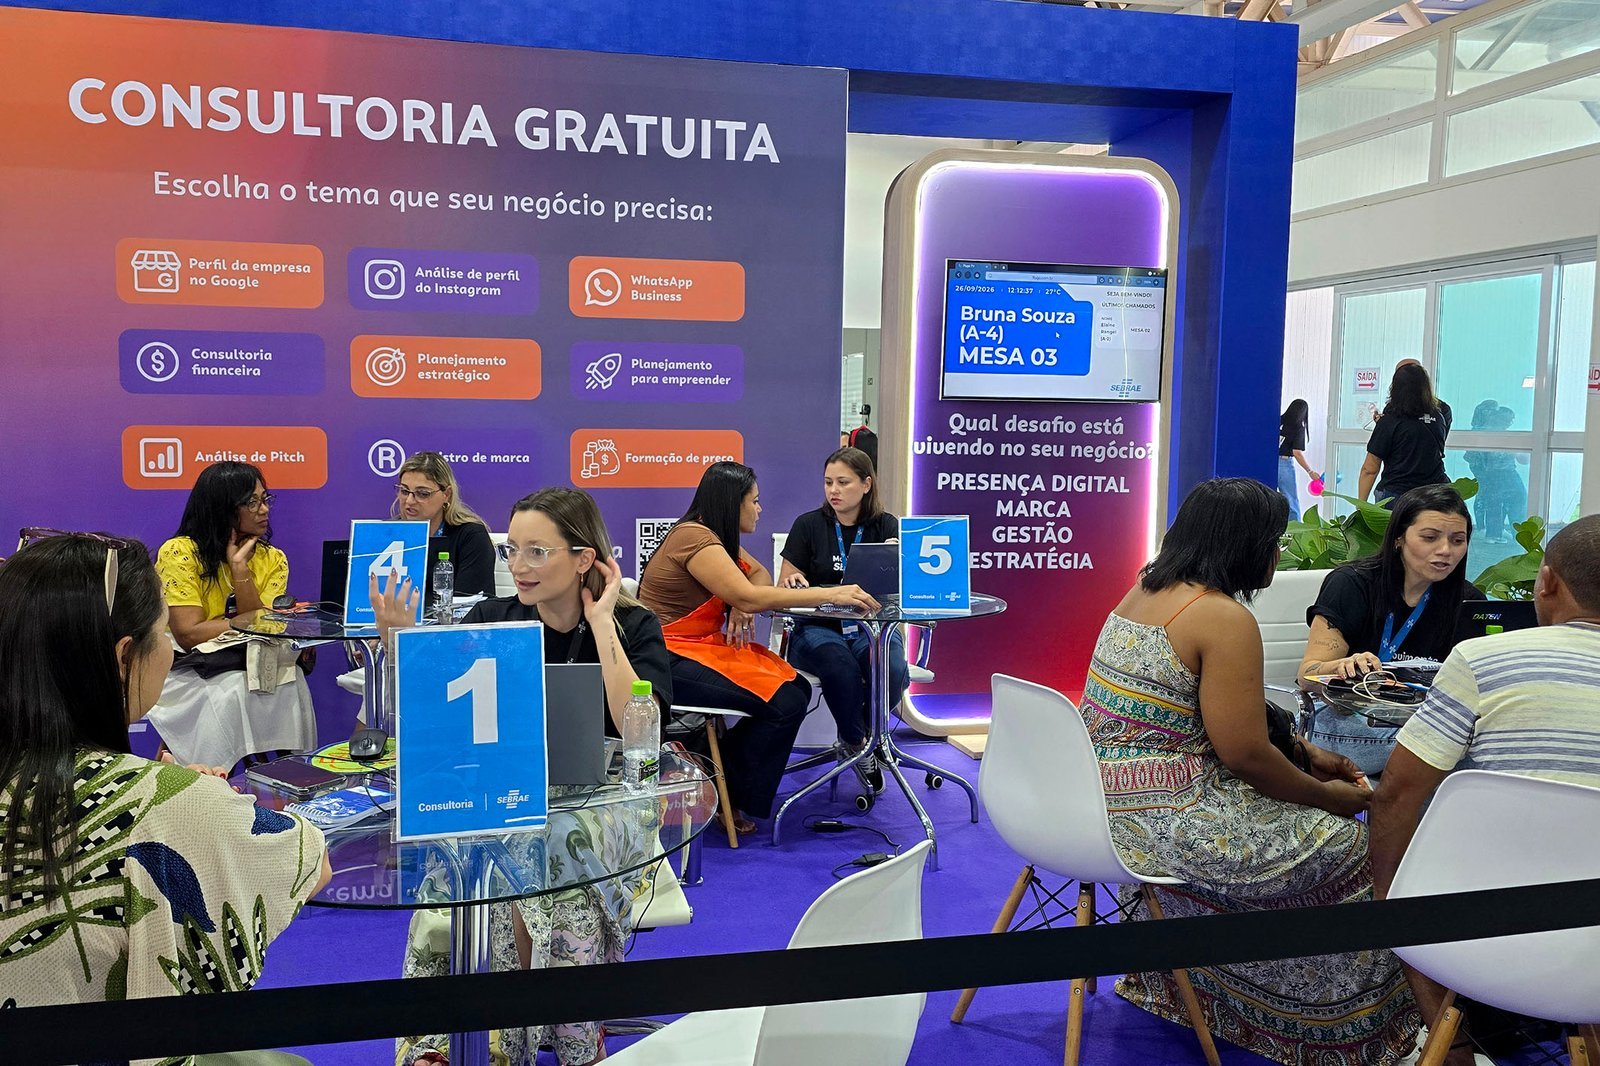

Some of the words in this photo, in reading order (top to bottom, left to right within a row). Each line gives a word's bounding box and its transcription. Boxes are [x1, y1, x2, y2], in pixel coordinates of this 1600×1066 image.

[68, 78, 497, 147] CONSULTORIA
[514, 108, 780, 163] GRATUITA
[154, 172, 270, 200] Escolha
[280, 183, 296, 201] o
[306, 181, 379, 205] tema
[389, 189, 439, 212] que
[448, 192, 493, 210] seu
[503, 191, 605, 220] negócio
[614, 198, 713, 222] precisa:
[189, 258, 227, 270] Perfil
[231, 260, 248, 271] da
[252, 263, 311, 274] empresa
[189, 278, 207, 286] no
[211, 275, 259, 289] Google
[415, 267, 464, 279] Análise
[467, 269, 483, 280] de
[486, 270, 520, 282] perfil
[631, 275, 693, 289] WhatsApp
[415, 283, 431, 293] do
[435, 283, 501, 297] Instagram
[631, 290, 682, 301] Business
[955, 285, 995, 293] 26/09/2026
[960, 305, 1016, 322] Bruna
[1021, 308, 1076, 324] Souza
[960, 325, 1004, 344] (A-4)
[191, 349, 272, 361] Consultoria
[418, 354, 507, 367] Planejamento
[959, 346, 1025, 365] MESA
[1030, 347, 1058, 366] 03
[192, 364, 261, 376] financeira
[631, 359, 712, 371] Planejamento
[418, 369, 490, 382] estratégico
[631, 375, 659, 386] para
[661, 374, 731, 387] empreender
[1357, 371, 1377, 381] SAÍDA
[949, 413, 999, 435] Qual
[1004, 414, 1077, 435] desafio
[1081, 417, 1124, 435] está
[195, 450, 247, 463] Análise
[251, 451, 267, 463] de
[270, 450, 305, 463] Pitch
[913, 436, 994, 455] vivendo
[1000, 443, 1026, 456] no
[1030, 443, 1064, 457] seu
[1071, 439, 1154, 463] negócio?
[472, 452, 487, 463] de
[490, 454, 530, 463] marca
[625, 453, 683, 465] Formação
[685, 453, 699, 463] de
[937, 472, 1046, 496] PRESENÇA
[1052, 474, 1130, 493] DIGITAL
[996, 500, 1071, 518] MARCA
[992, 522, 1073, 544] GESTÃO
[368, 541, 408, 584] 4
[918, 535, 953, 575] 5
[970, 547, 1094, 570] ESTRATÉGIA
[446, 657, 499, 745] 1
[418, 799, 474, 812] Consultoria
[497, 794, 530, 804] SEBRAE
